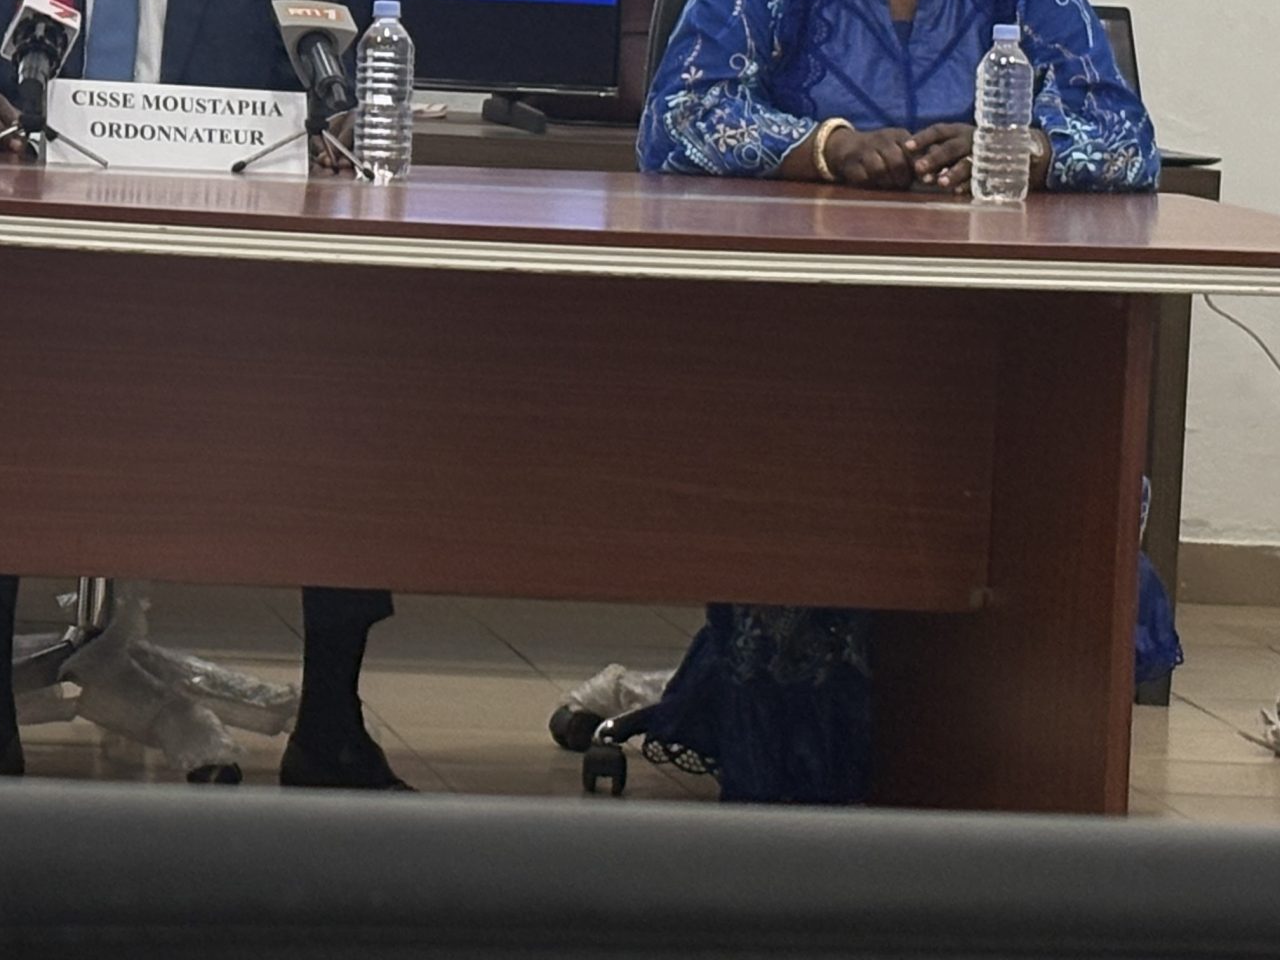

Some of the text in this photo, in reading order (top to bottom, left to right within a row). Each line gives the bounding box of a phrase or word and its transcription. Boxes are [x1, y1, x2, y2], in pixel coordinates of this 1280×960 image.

[71, 89, 283, 117] CISSE MOUSTAPHA
[90, 120, 265, 146] ORDONNATEUR
